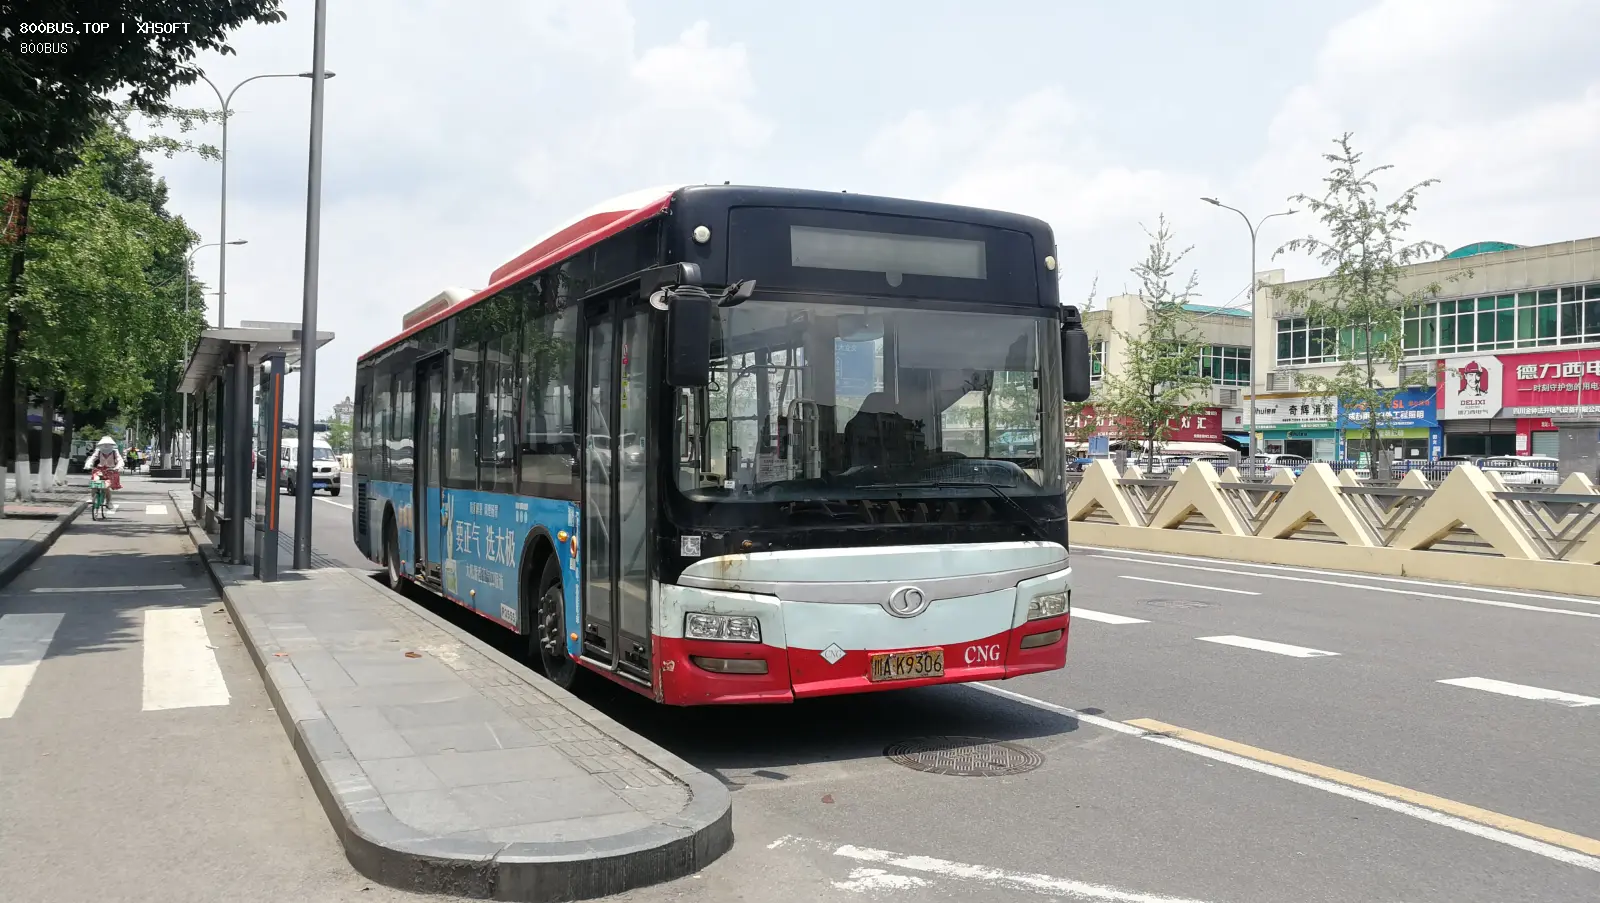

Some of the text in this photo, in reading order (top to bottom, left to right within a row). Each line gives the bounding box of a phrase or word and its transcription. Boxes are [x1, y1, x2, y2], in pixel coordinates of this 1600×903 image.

[1533, 382, 1600, 392] 时刻守护您的用电
[824, 649, 842, 658] CNG
[964, 644, 1000, 664] CNG
